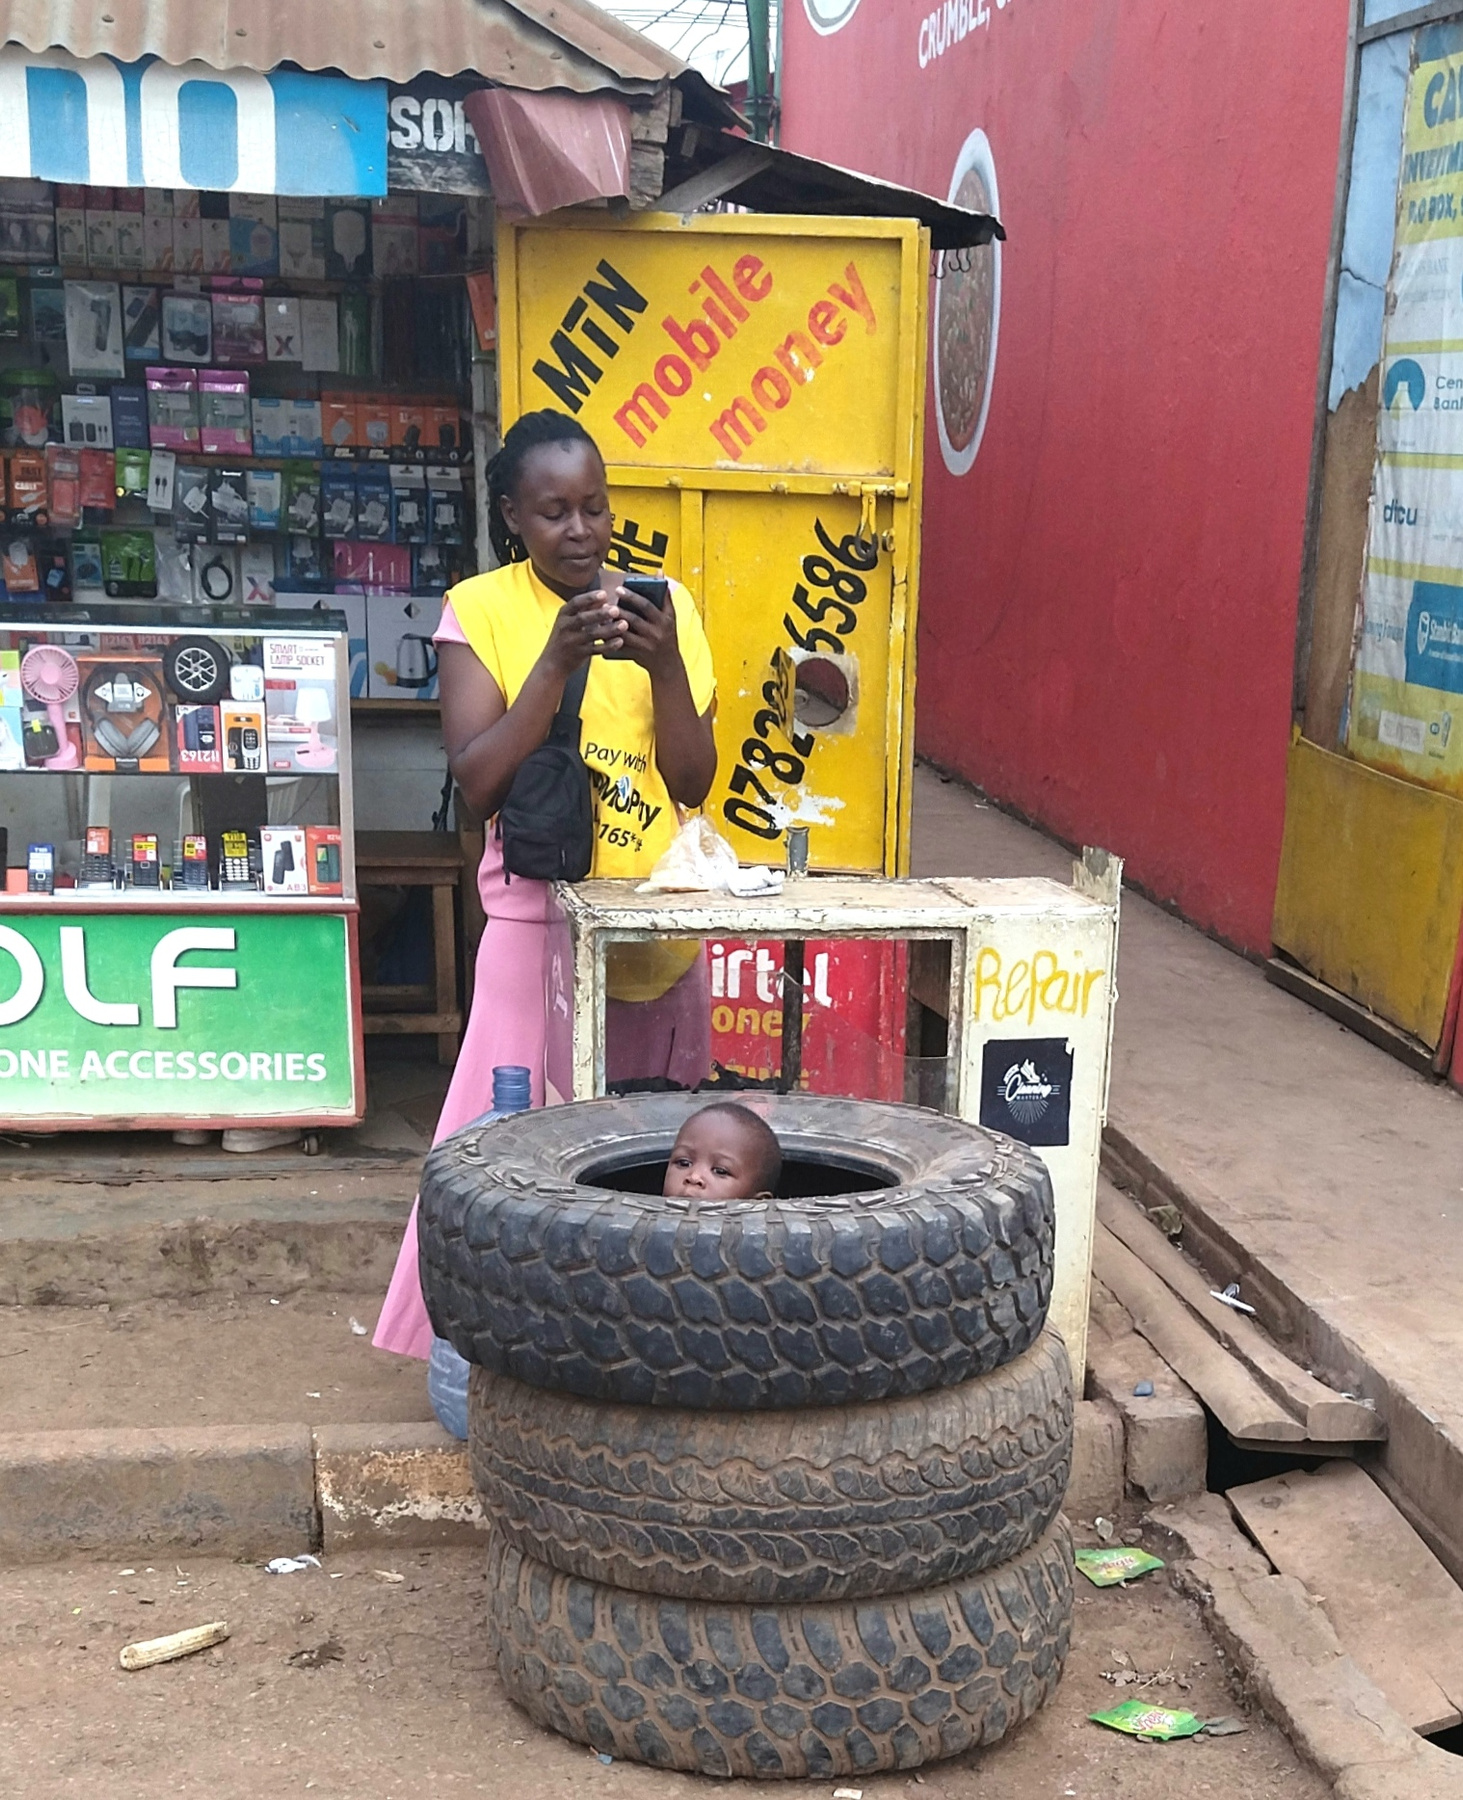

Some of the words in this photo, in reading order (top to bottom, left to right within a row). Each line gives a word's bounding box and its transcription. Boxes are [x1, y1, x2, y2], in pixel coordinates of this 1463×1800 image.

[1424, 64, 1463, 129] CA
[532, 258, 649, 414] MTN
[613, 253, 773, 449] mobile
[709, 261, 877, 461] money
[270, 654, 293, 665] LAMP
[296, 655, 325, 667] SOCKET
[584, 741, 622, 767] Pay
[624, 751, 647, 774] with
[973, 946, 1106, 1027] Repair
[79, 1049, 328, 1082] ACCESSORIES
